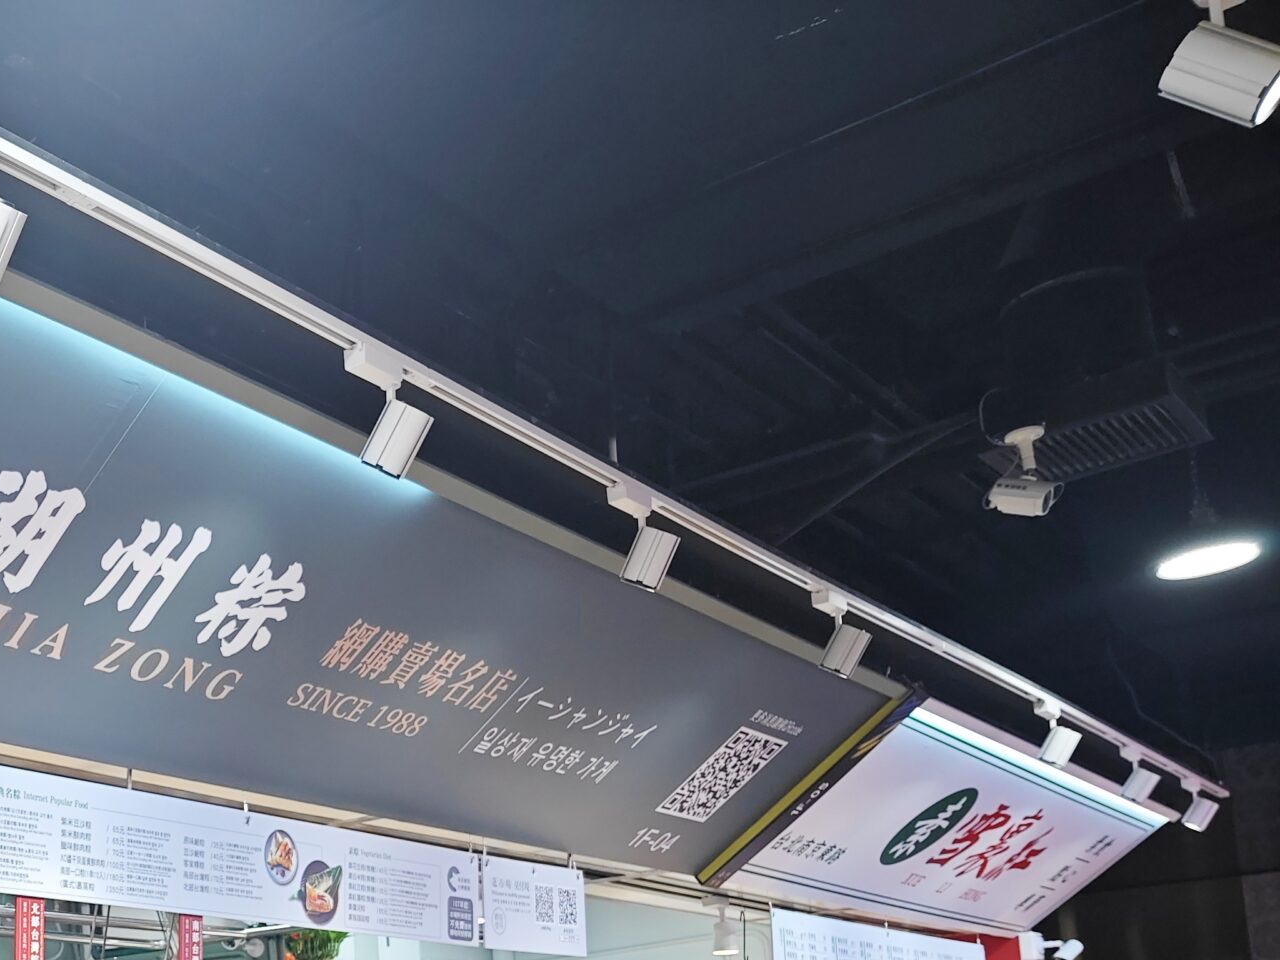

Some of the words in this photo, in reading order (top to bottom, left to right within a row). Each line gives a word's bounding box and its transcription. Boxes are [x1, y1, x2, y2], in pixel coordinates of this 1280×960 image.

[93, 637, 244, 704] ZONG
[319, 618, 518, 713] 網購賣場名店
[287, 682, 373, 723] SINCE
[367, 704, 428, 738] 1988
[527, 742, 585, 775] 유명한
[576, 758, 619, 785] 가게
[628, 827, 681, 853] 1F-04
